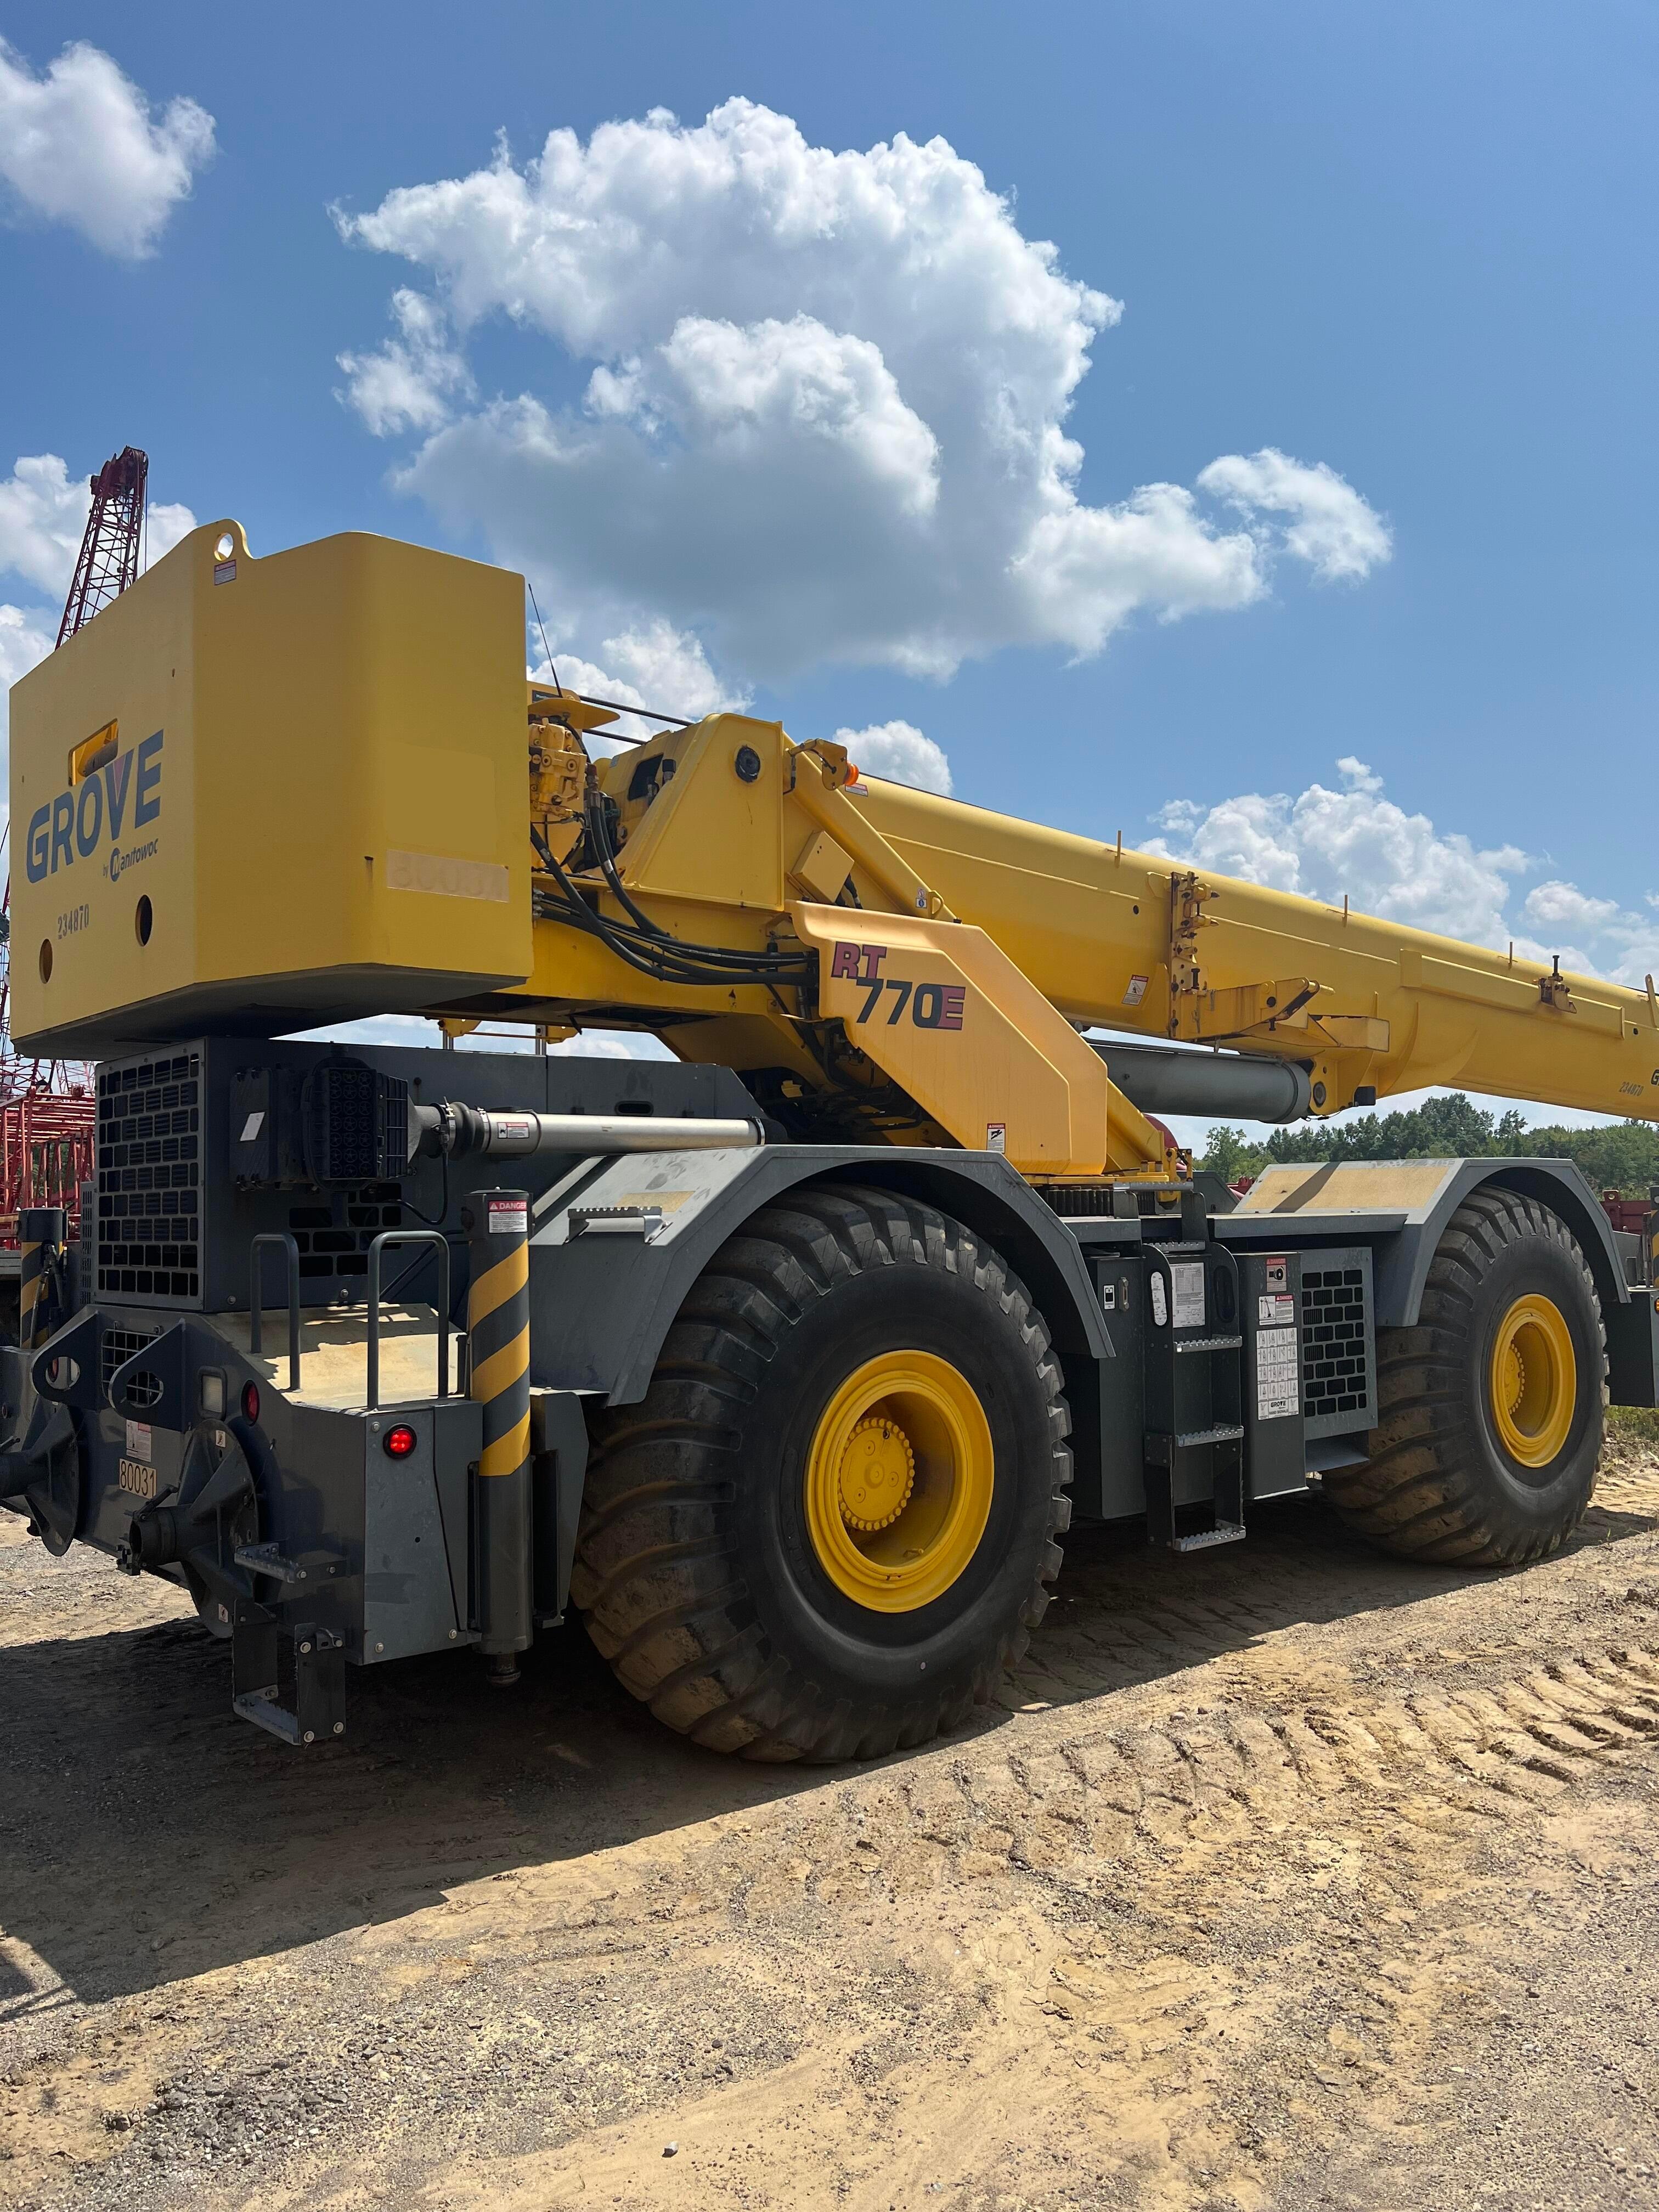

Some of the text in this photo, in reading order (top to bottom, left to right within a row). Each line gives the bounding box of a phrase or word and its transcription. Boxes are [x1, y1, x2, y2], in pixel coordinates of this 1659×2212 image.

[26, 729, 164, 884] GROVE
[110, 838, 159, 882] Manitowoc
[58, 904, 89, 940] 234870
[831, 941, 888, 980] RT
[855, 977, 966, 1031] 770E
[121, 1460, 154, 1497] 80031
